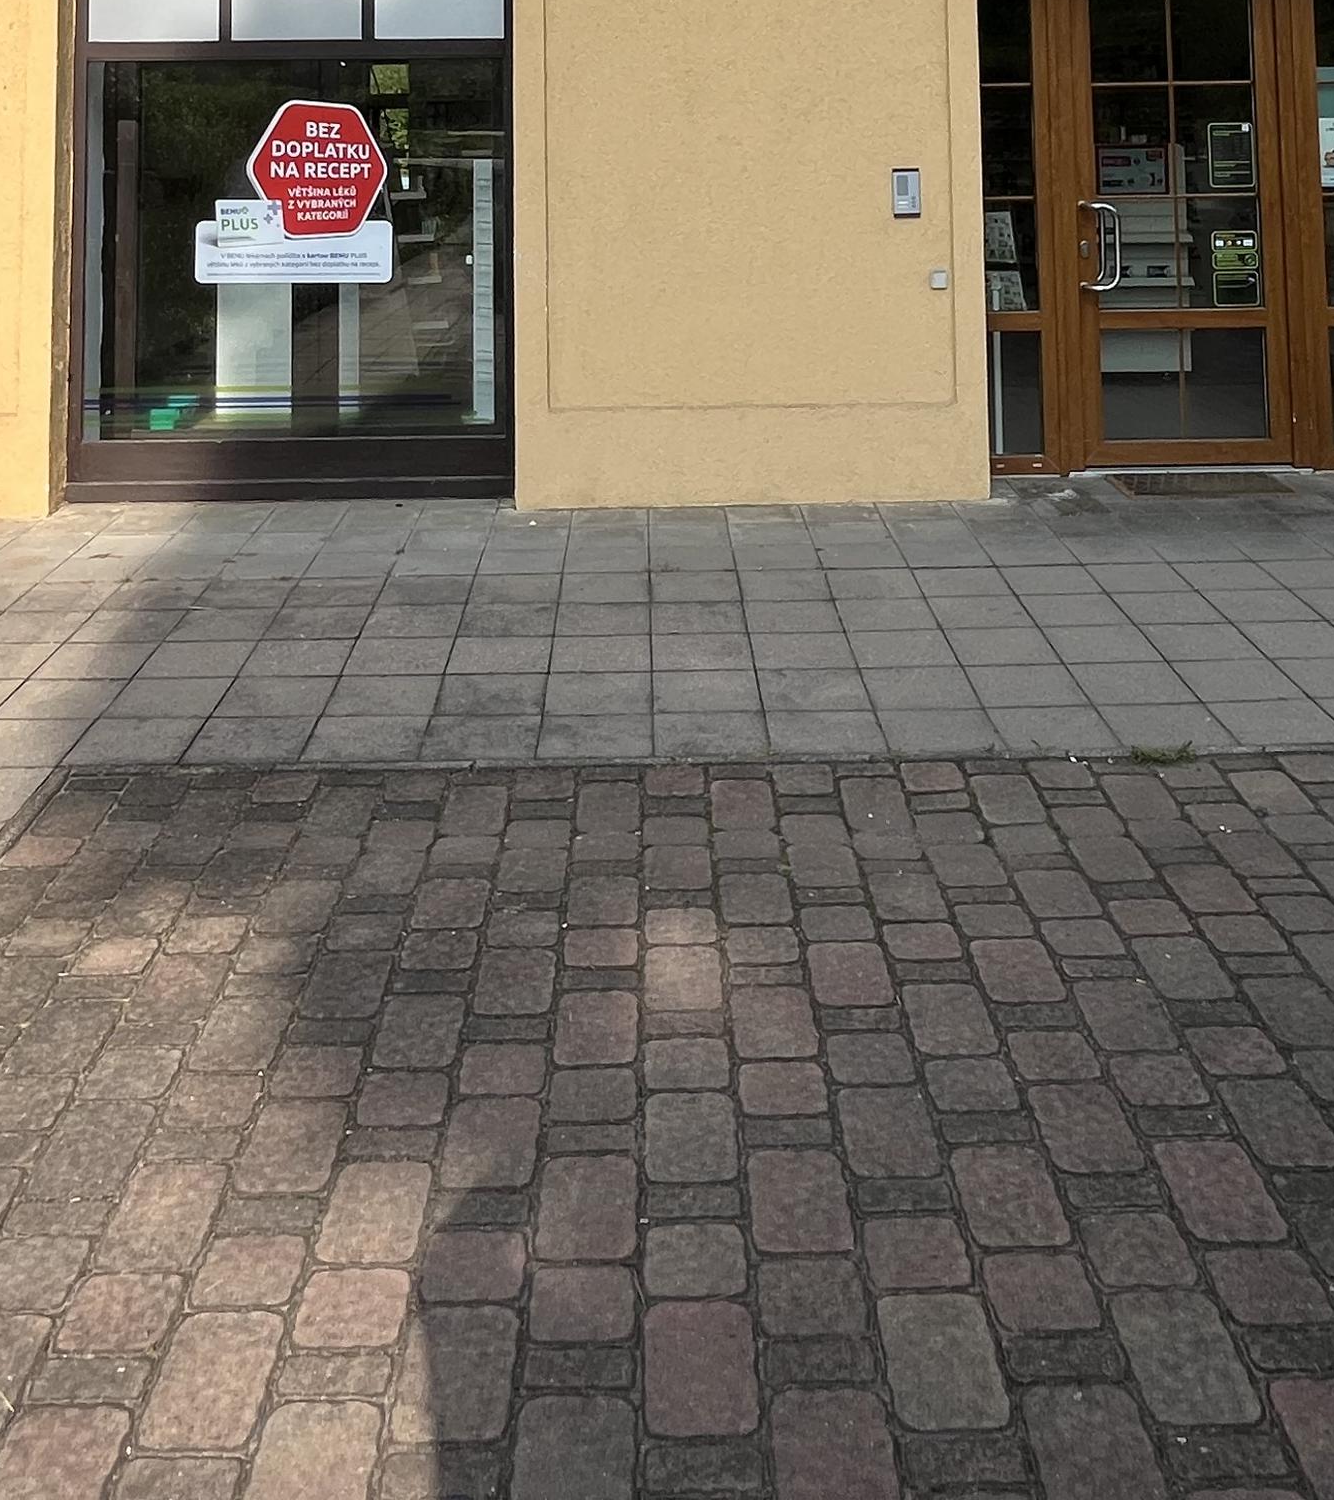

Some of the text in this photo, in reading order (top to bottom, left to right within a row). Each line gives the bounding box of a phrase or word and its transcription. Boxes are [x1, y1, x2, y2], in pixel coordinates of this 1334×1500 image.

[305, 121, 342, 139] BEZ
[270, 140, 371, 160] DOPLATKU
[269, 161, 372, 179] NA RECEPT
[287, 185, 357, 197] VĚTŠINA LÉKŮ
[287, 198, 357, 209] Z VYBRANÝCH
[221, 218, 259, 231] PLUS
